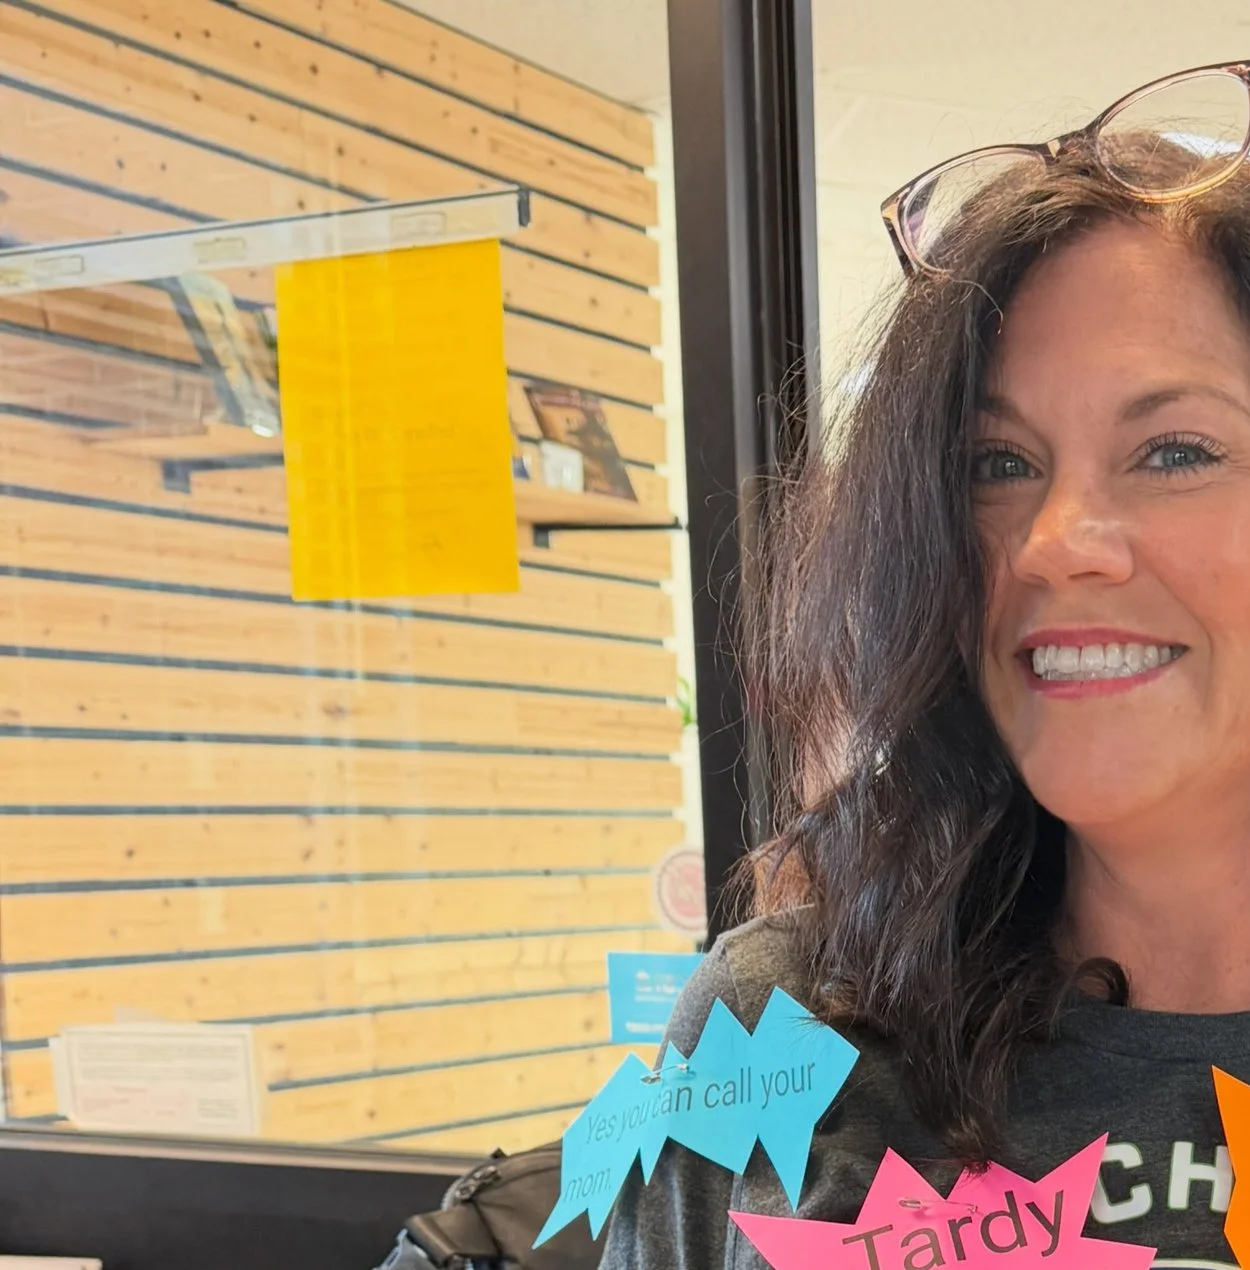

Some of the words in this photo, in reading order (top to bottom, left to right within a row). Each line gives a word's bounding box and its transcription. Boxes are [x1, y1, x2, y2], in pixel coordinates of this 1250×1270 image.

[587, 1115, 615, 1144] Yes
[615, 1102, 648, 1143] you
[651, 1085, 692, 1119] can
[704, 1066, 751, 1109] call
[761, 1061, 816, 1110] your
[563, 1167, 612, 1203] mom.
